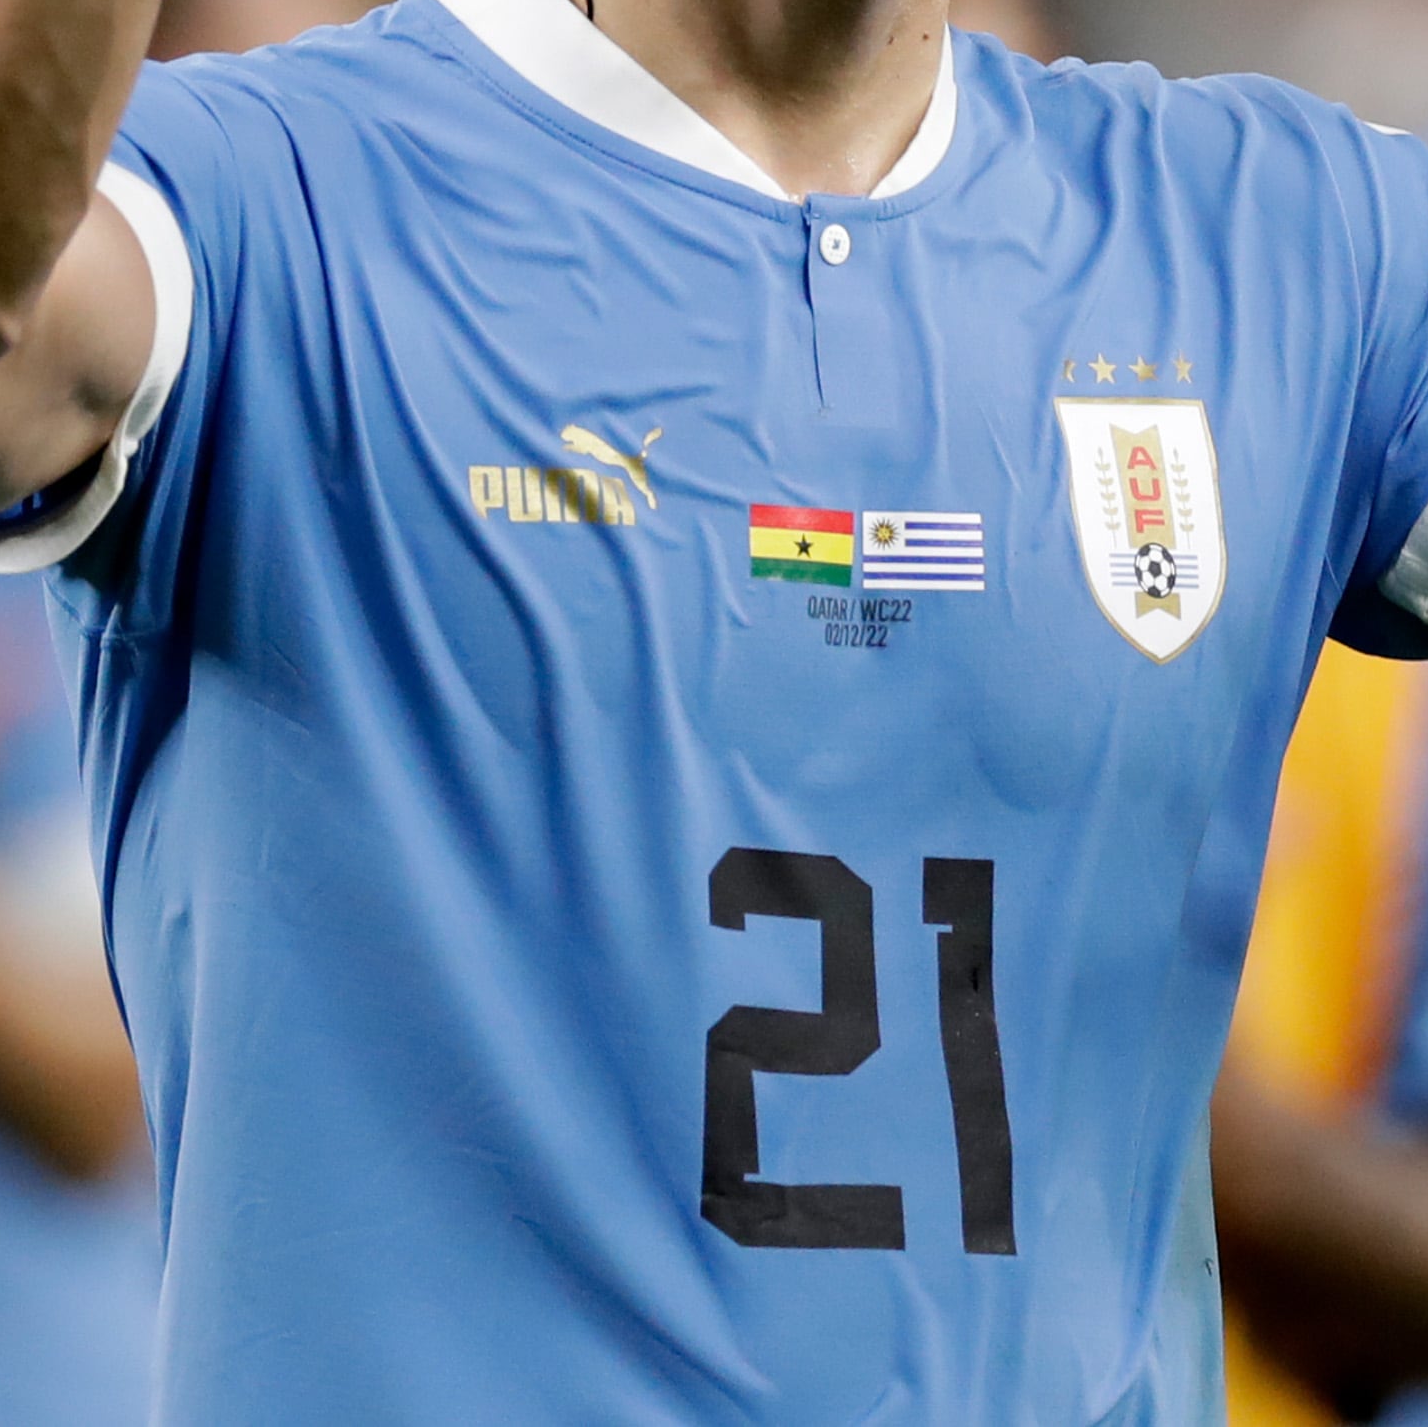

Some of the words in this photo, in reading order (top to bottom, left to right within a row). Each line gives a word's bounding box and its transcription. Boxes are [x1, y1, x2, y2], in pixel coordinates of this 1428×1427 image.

[468, 465, 636, 526] PUMA
[1128, 446, 1165, 534] AUF
[824, 622, 888, 648] 02/12/22
[859, 599, 912, 622] WC22
[700, 847, 1017, 1256] 21
